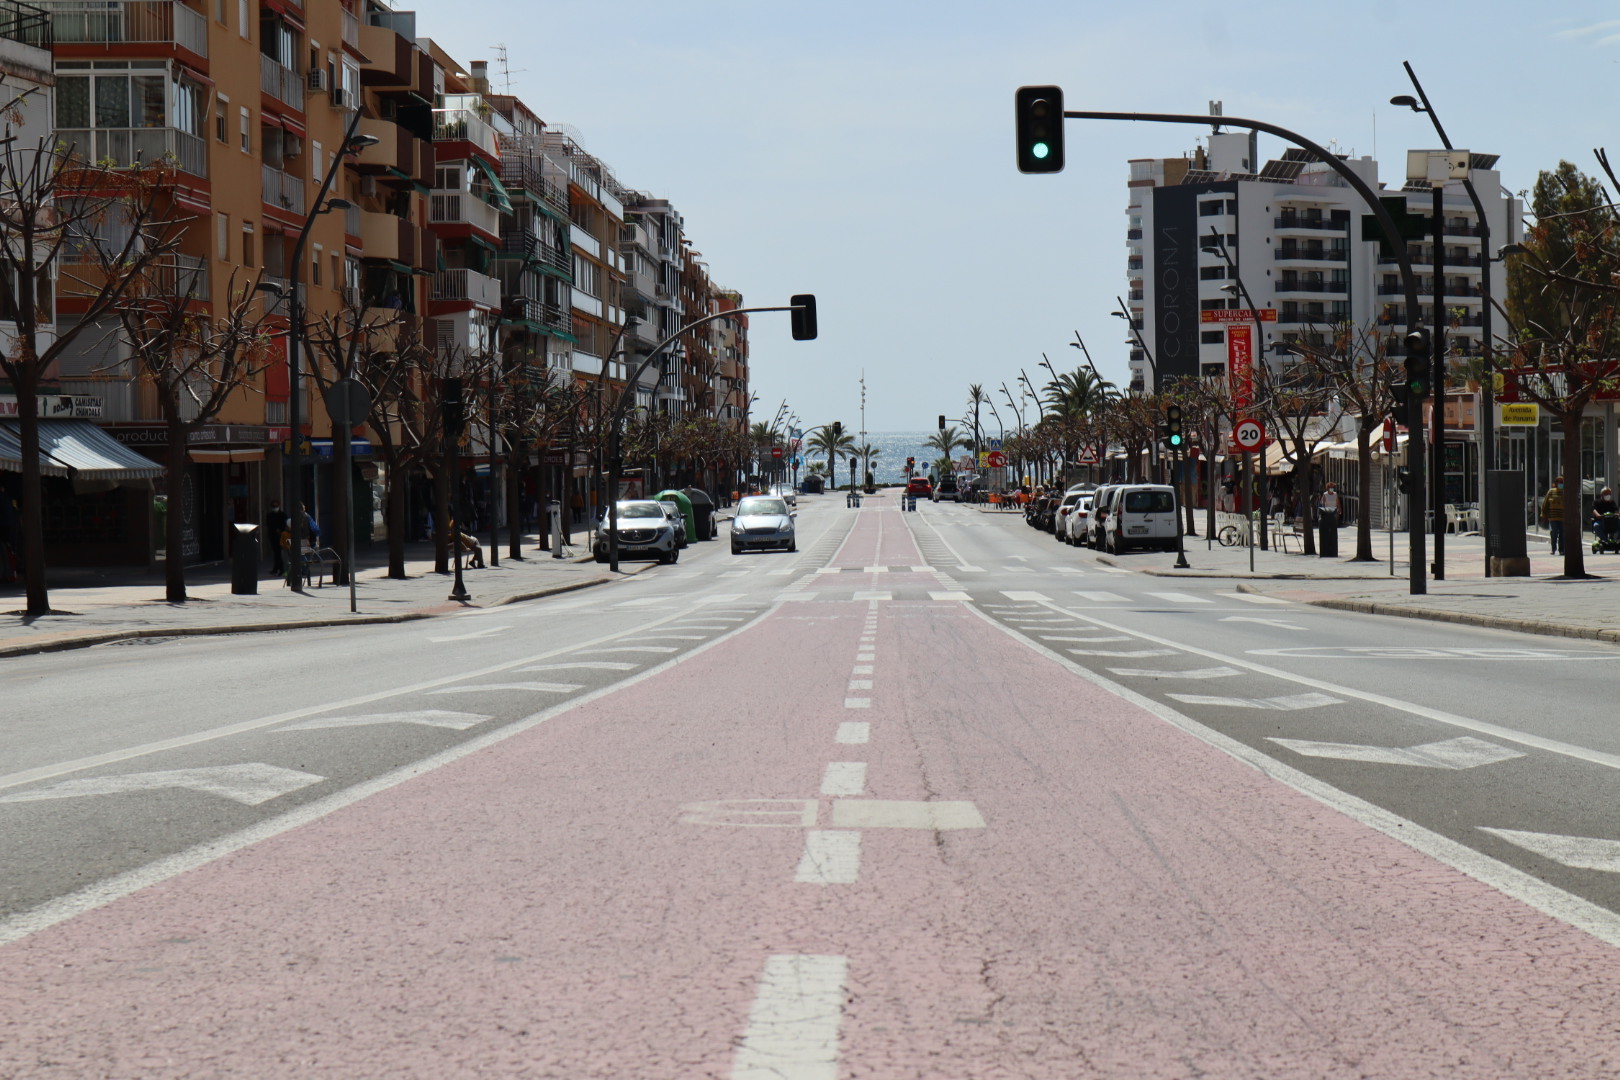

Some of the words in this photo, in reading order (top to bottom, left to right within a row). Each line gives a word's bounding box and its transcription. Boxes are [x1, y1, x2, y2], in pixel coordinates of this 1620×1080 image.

[1162, 227, 1181, 358] CORONA
[1213, 310, 1263, 318] SUPERCALA
[75, 397, 102, 407] CAMISETAS
[75, 407, 101, 417] CHANDALS
[1240, 429, 1259, 441] 20
